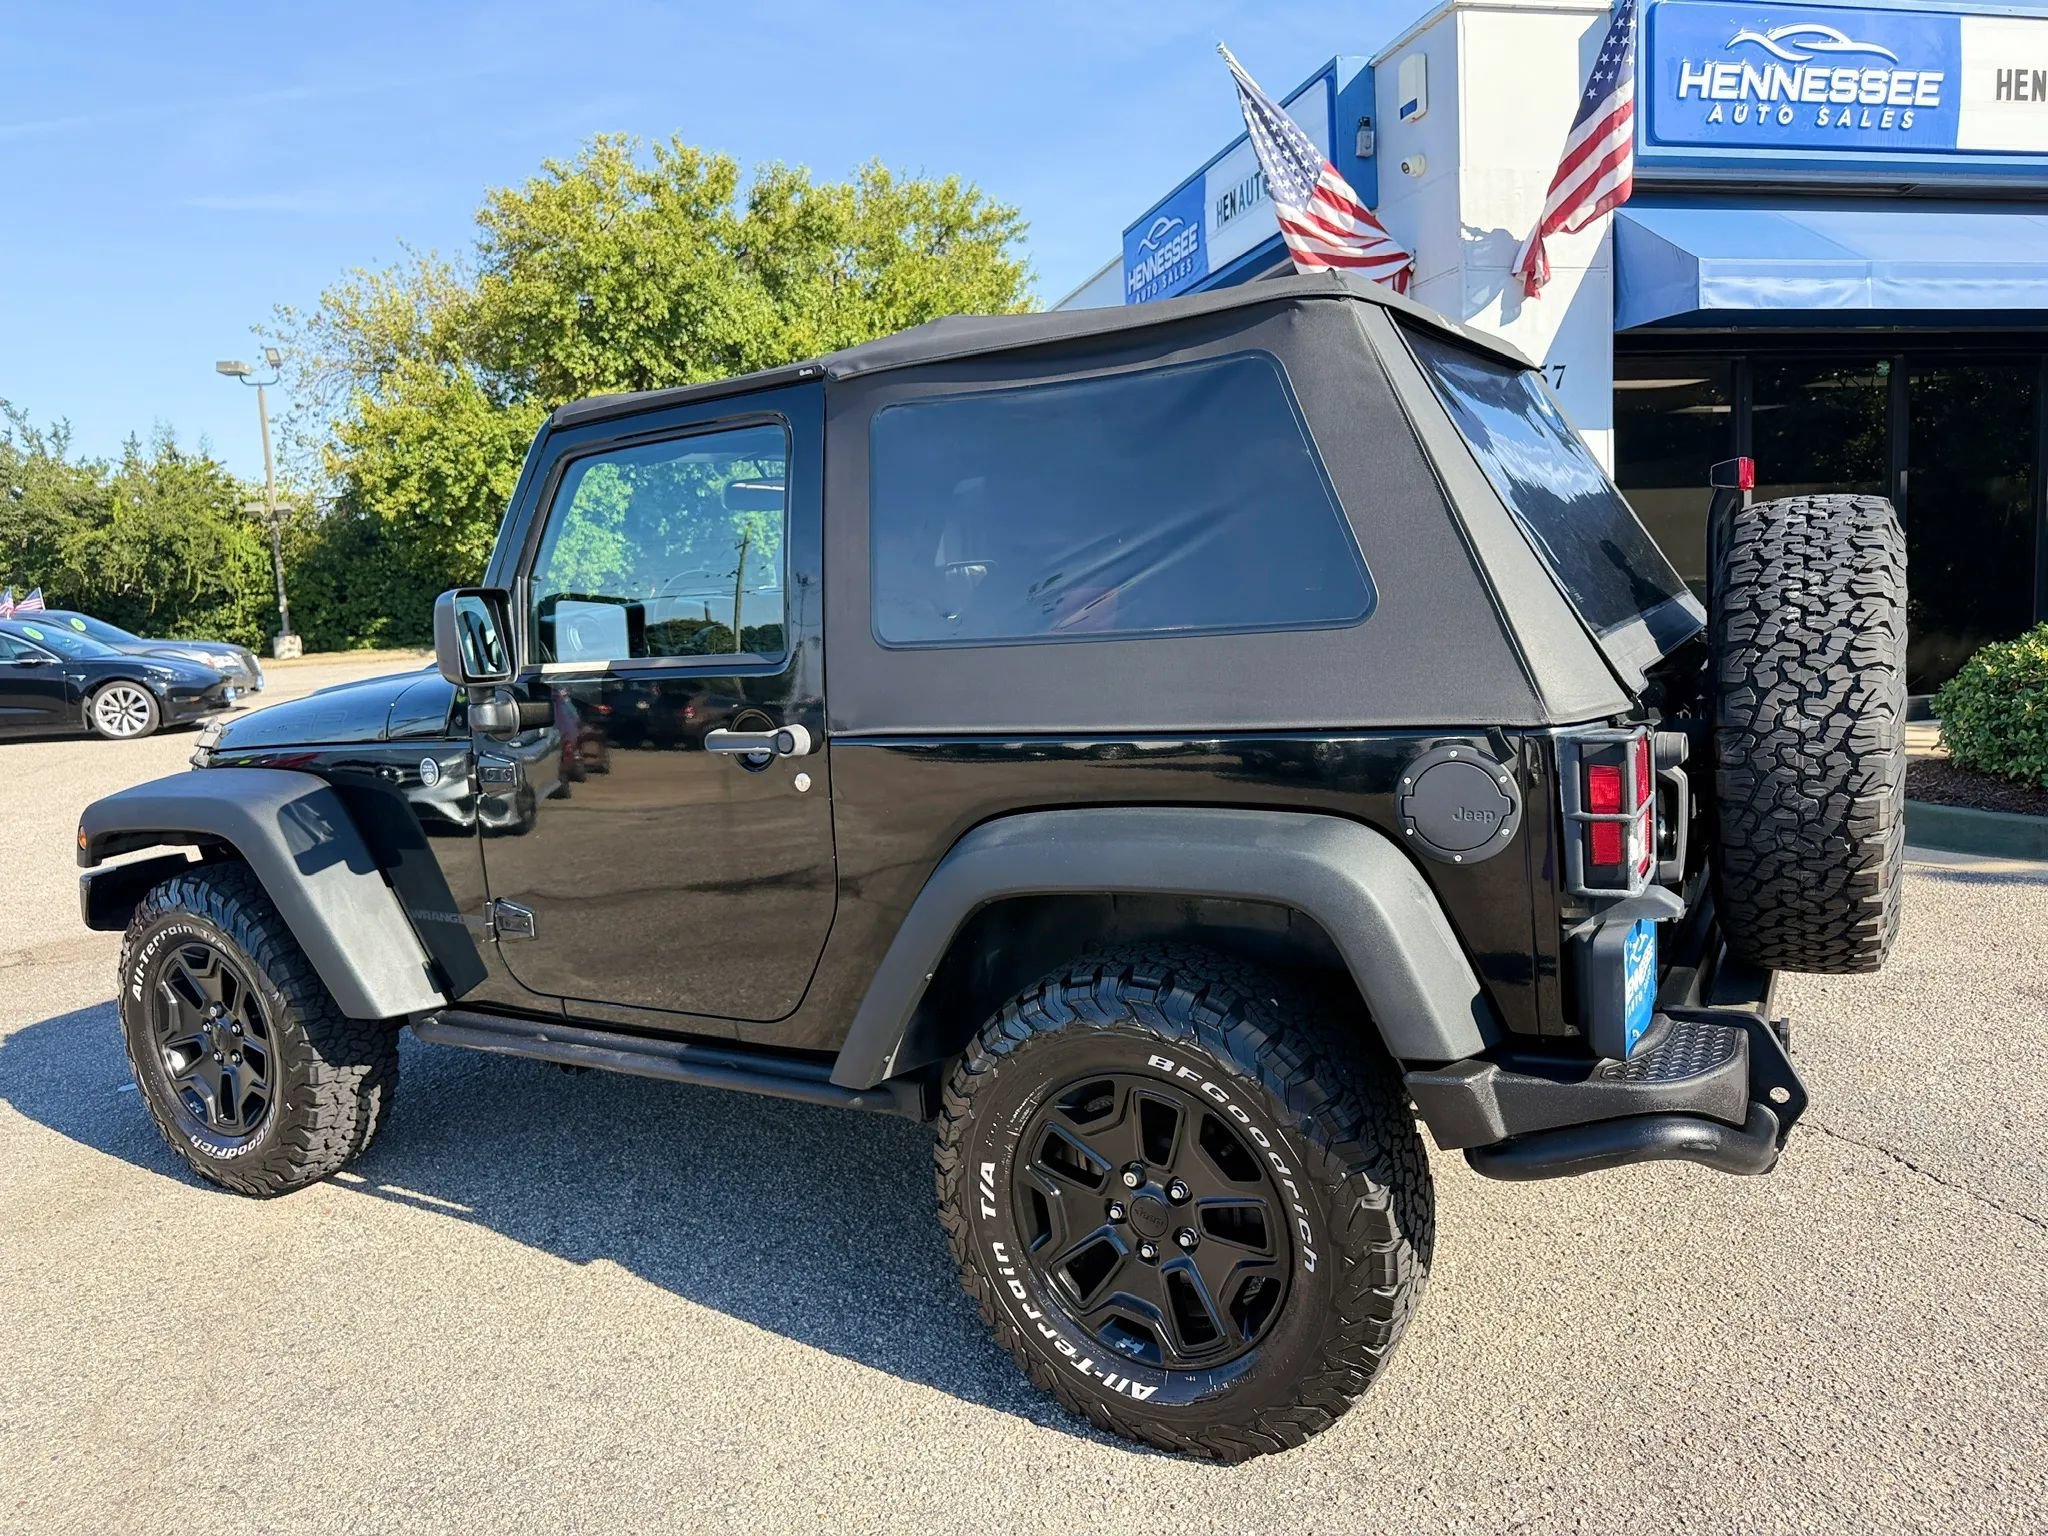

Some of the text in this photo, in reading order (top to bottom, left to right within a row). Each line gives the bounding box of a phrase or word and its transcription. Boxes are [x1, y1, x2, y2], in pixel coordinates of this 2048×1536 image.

[1678, 59, 1944, 107] HENNESSEE
[1996, 68, 2047, 102] HEN
[1707, 103, 1915, 130] AUTO SALES
[1127, 221, 1199, 296] HENNESSEE
[1135, 257, 1193, 304] AUTO SALES
[1451, 806, 1495, 824] Jeep
[132, 924, 193, 1002] All-Terrain
[1148, 1054, 1318, 1273] BFGoodrich
[980, 1162, 1158, 1400] All-Terrain T/A
